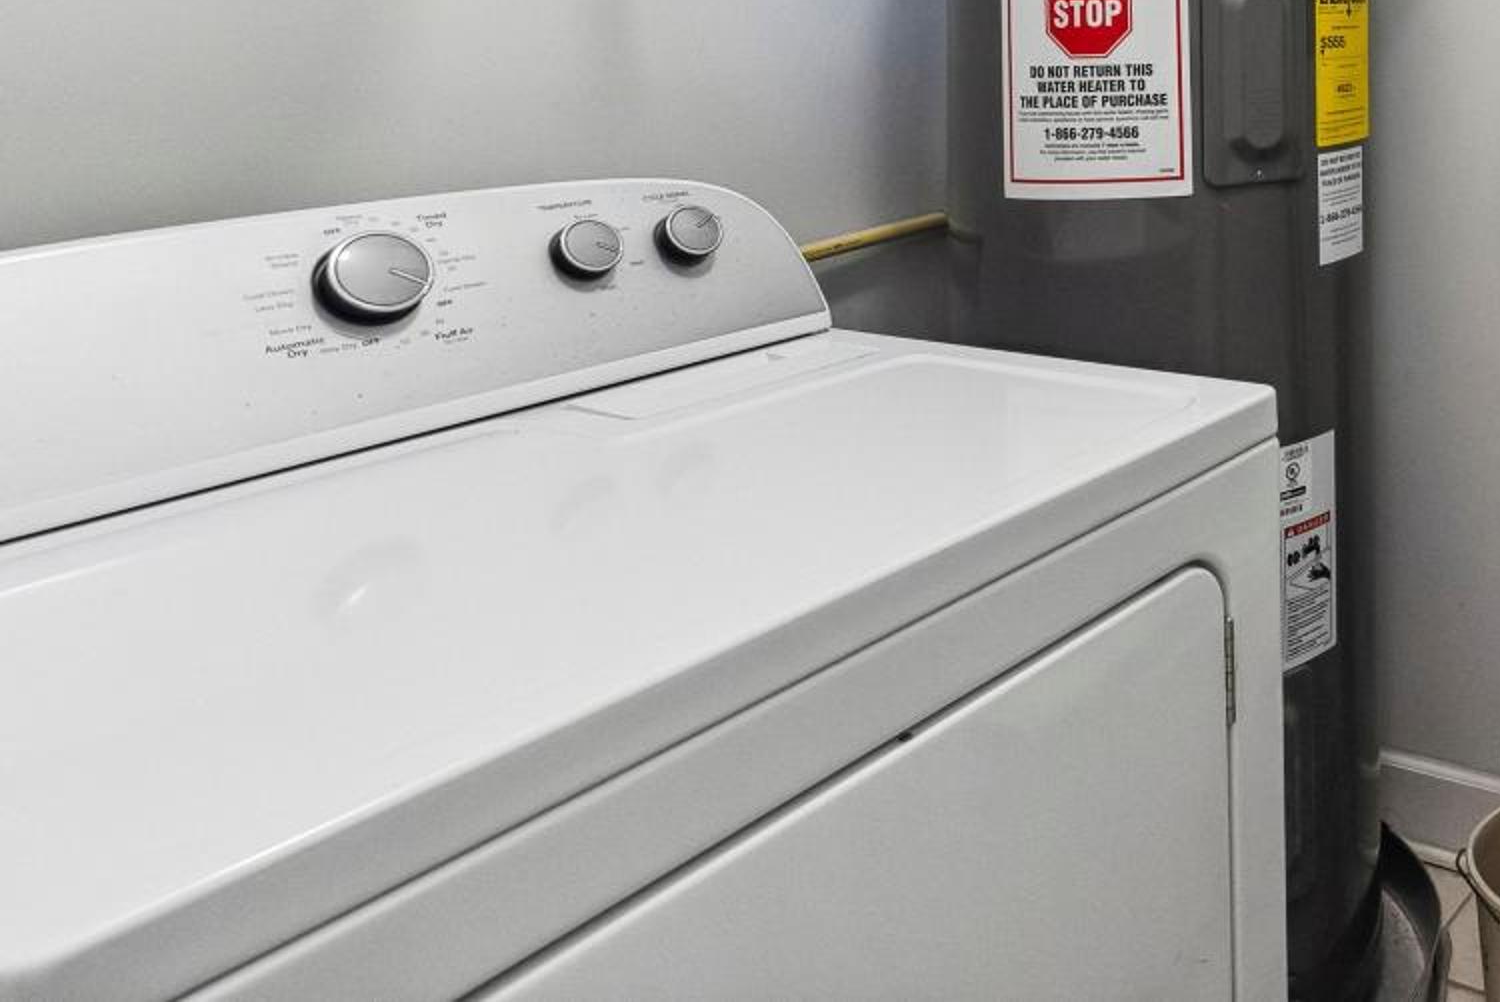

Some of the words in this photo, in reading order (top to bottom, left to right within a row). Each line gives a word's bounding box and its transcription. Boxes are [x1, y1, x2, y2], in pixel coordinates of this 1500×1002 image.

[1030, 67, 1045, 79] DO
[1047, 66, 1069, 78] NOT
[1073, 65, 1121, 78] RETURN
[1126, 63, 1153, 76] THIS
[1037, 80, 1076, 93] WATER
[1079, 79, 1125, 93] HEATER
[1130, 78, 1146, 91] TO
[1020, 96, 1040, 109] THE
[1043, 95, 1078, 109] PLACE
[1083, 95, 1098, 108] OF
[1101, 93, 1168, 108] PURCHASE
[265, 337, 325, 354] Automatic
[287, 348, 310, 359] Dry
